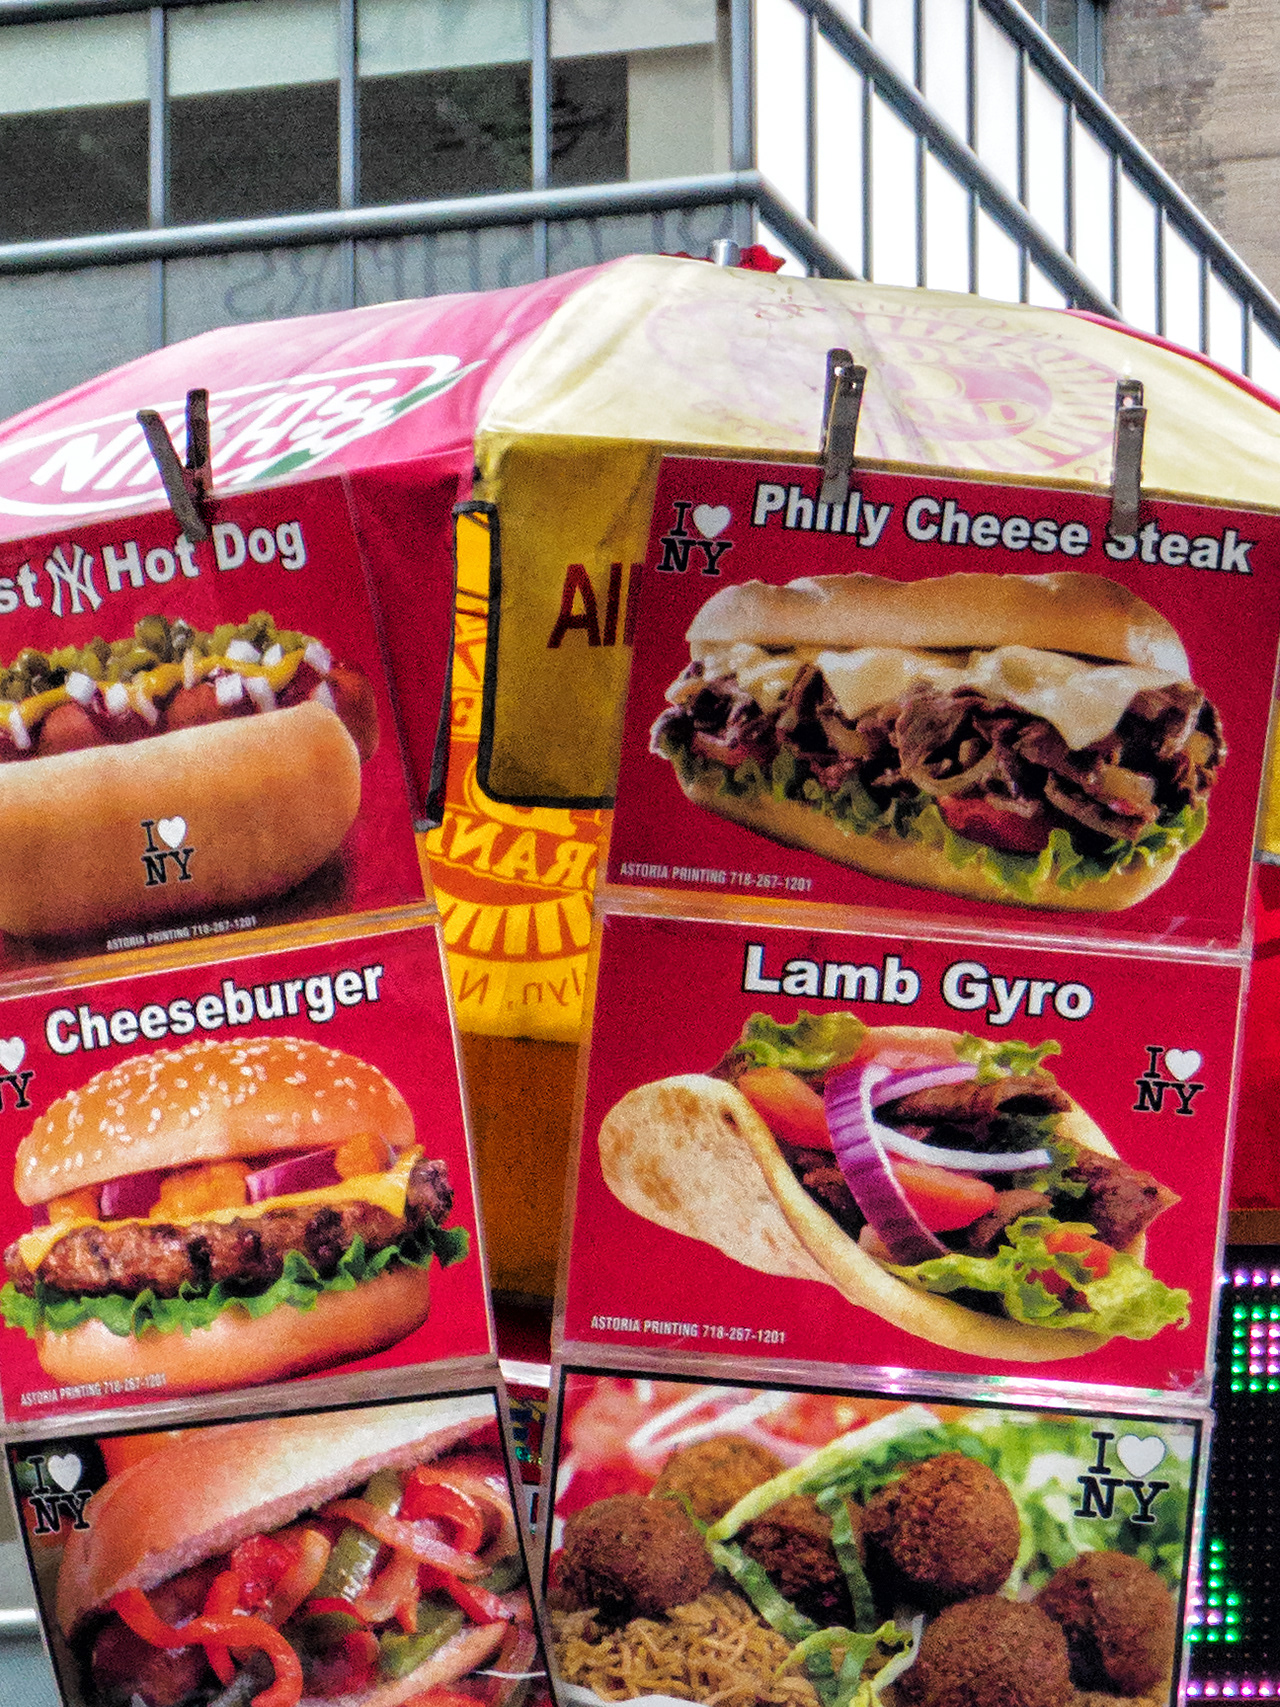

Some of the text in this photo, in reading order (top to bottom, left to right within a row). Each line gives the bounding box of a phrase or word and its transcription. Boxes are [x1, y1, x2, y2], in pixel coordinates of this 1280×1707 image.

[670, 501, 689, 537] I
[753, 484, 892, 546] Philly
[905, 497, 1090, 556] Cheese
[102, 536, 200, 592] Hot
[213, 520, 306, 572] Dog
[657, 538, 732, 576] NY
[141, 820, 158, 852] I
[143, 848, 194, 886] NY
[620, 863, 668, 881] ASTORIA
[672, 867, 725, 884] PRINTING
[743, 943, 1093, 1026] Lamb Gyro
[44, 965, 384, 1055] Cheeseburger
[1143, 1045, 1163, 1078] I
[1132, 1079, 1204, 1115] NY
[591, 1315, 785, 1344] ASTORIA PRINTING 718-267-1201
[1090, 1431, 1112, 1475] I
[26, 1456, 50, 1493] I
[29, 1491, 91, 1534] NY
[1074, 1475, 1170, 1523] NY
